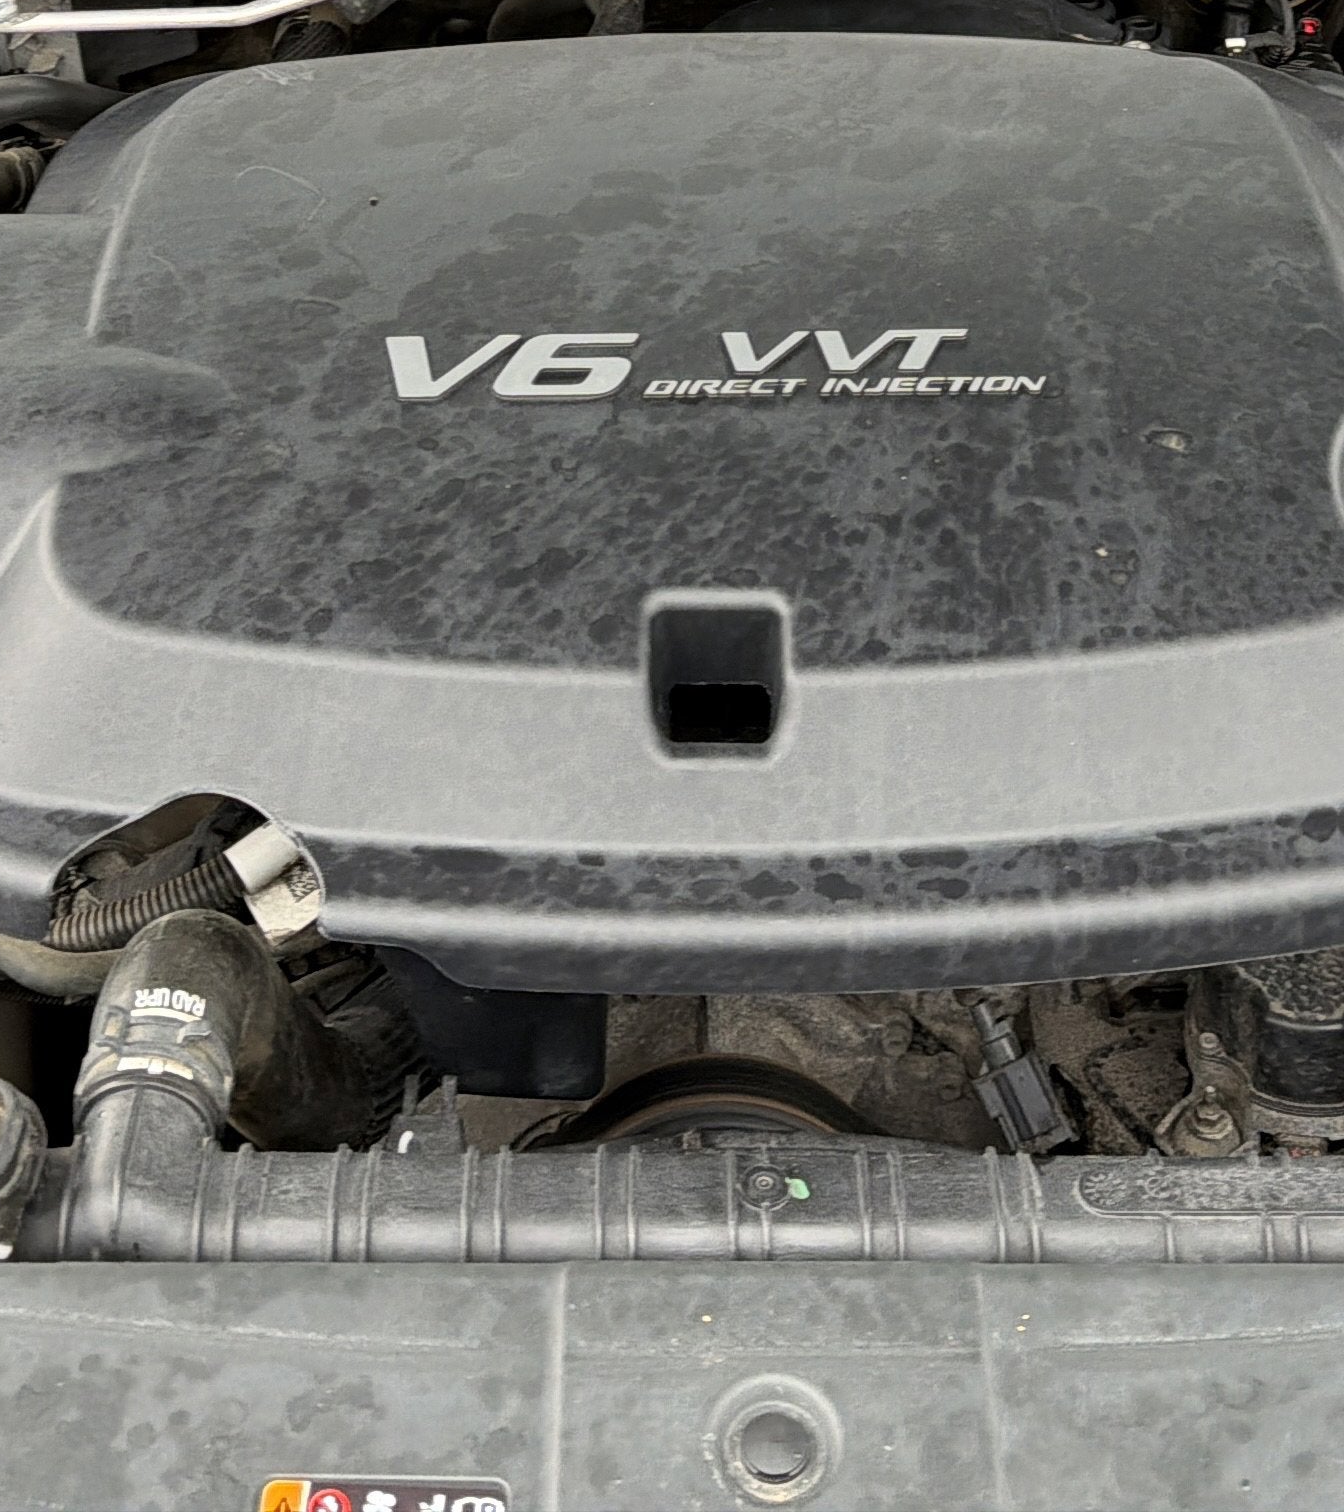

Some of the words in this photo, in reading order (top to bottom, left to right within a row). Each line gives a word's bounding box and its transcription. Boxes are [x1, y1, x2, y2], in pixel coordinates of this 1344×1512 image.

[722, 329, 968, 373] VVT
[385, 332, 640, 399] V6
[643, 378, 807, 398] DIRECT
[820, 376, 1046, 396] INJECTION
[135, 988, 170, 1007] UPR
[172, 990, 206, 1017] RAD
